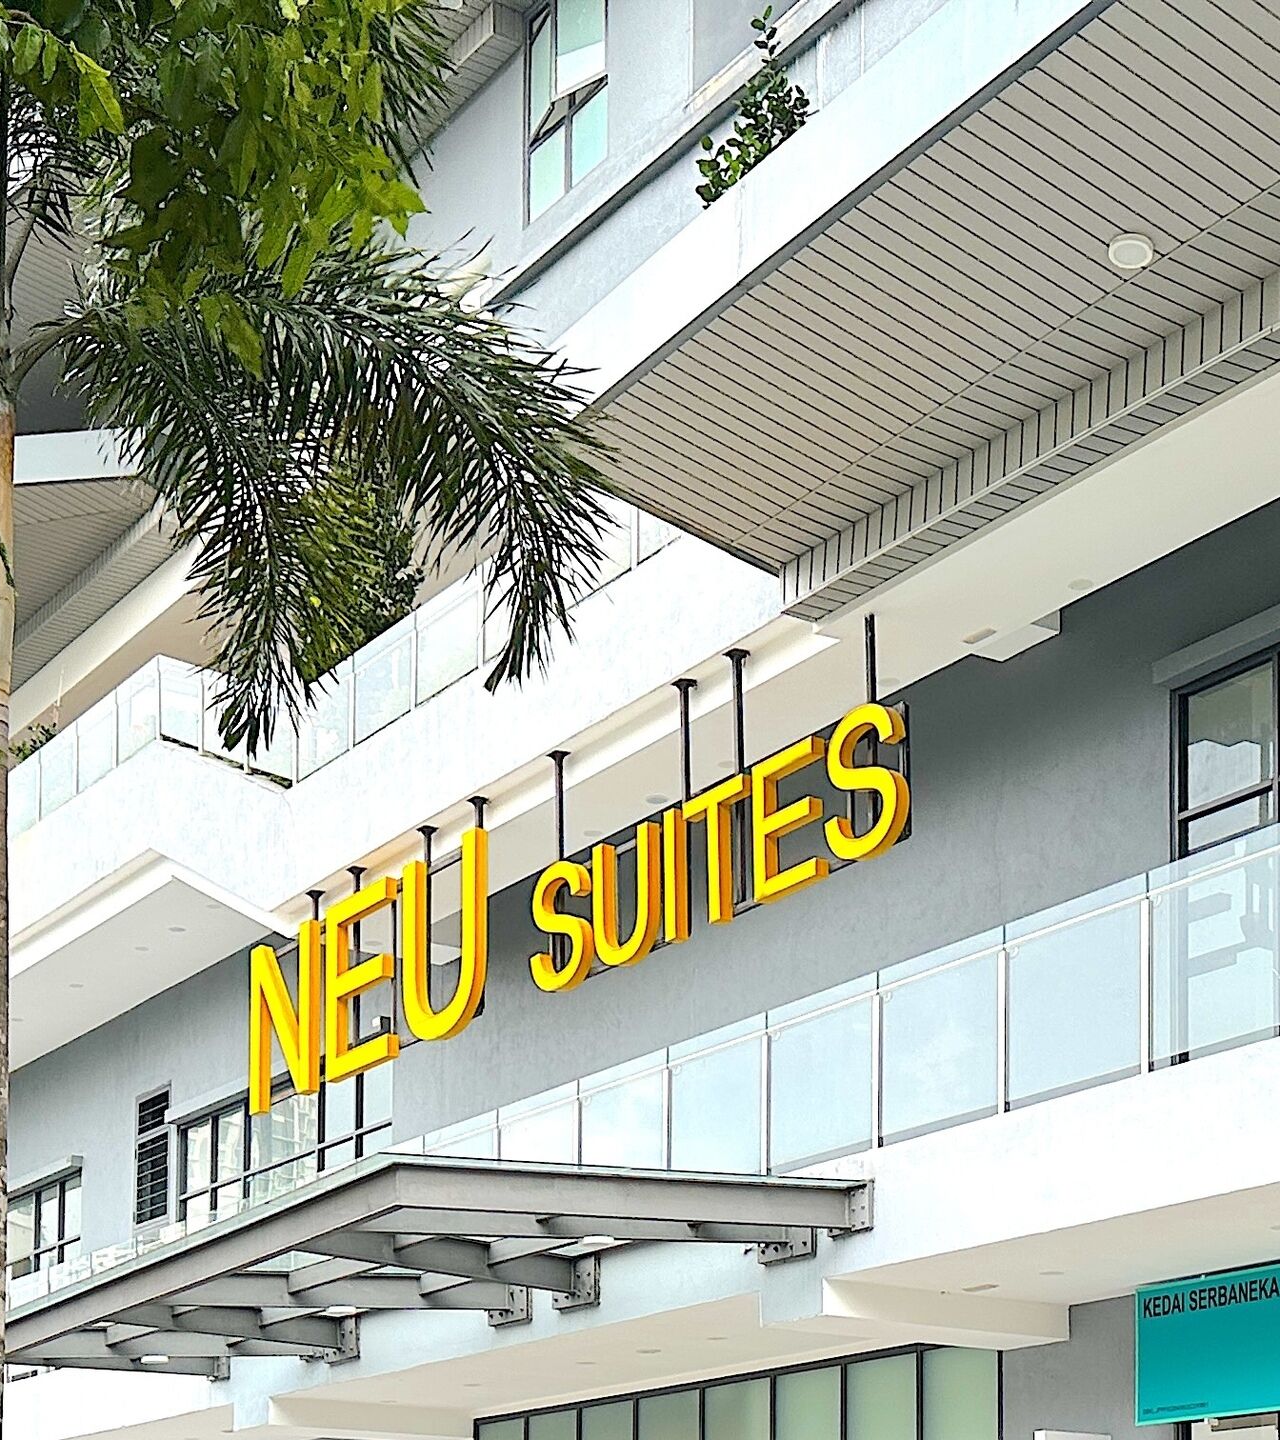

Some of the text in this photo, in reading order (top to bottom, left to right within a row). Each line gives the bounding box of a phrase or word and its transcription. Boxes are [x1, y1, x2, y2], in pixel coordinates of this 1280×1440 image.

[248, 701, 911, 1116] NEU SUITES
[1144, 1277, 1280, 1318] KEDAI SERBANEKA
